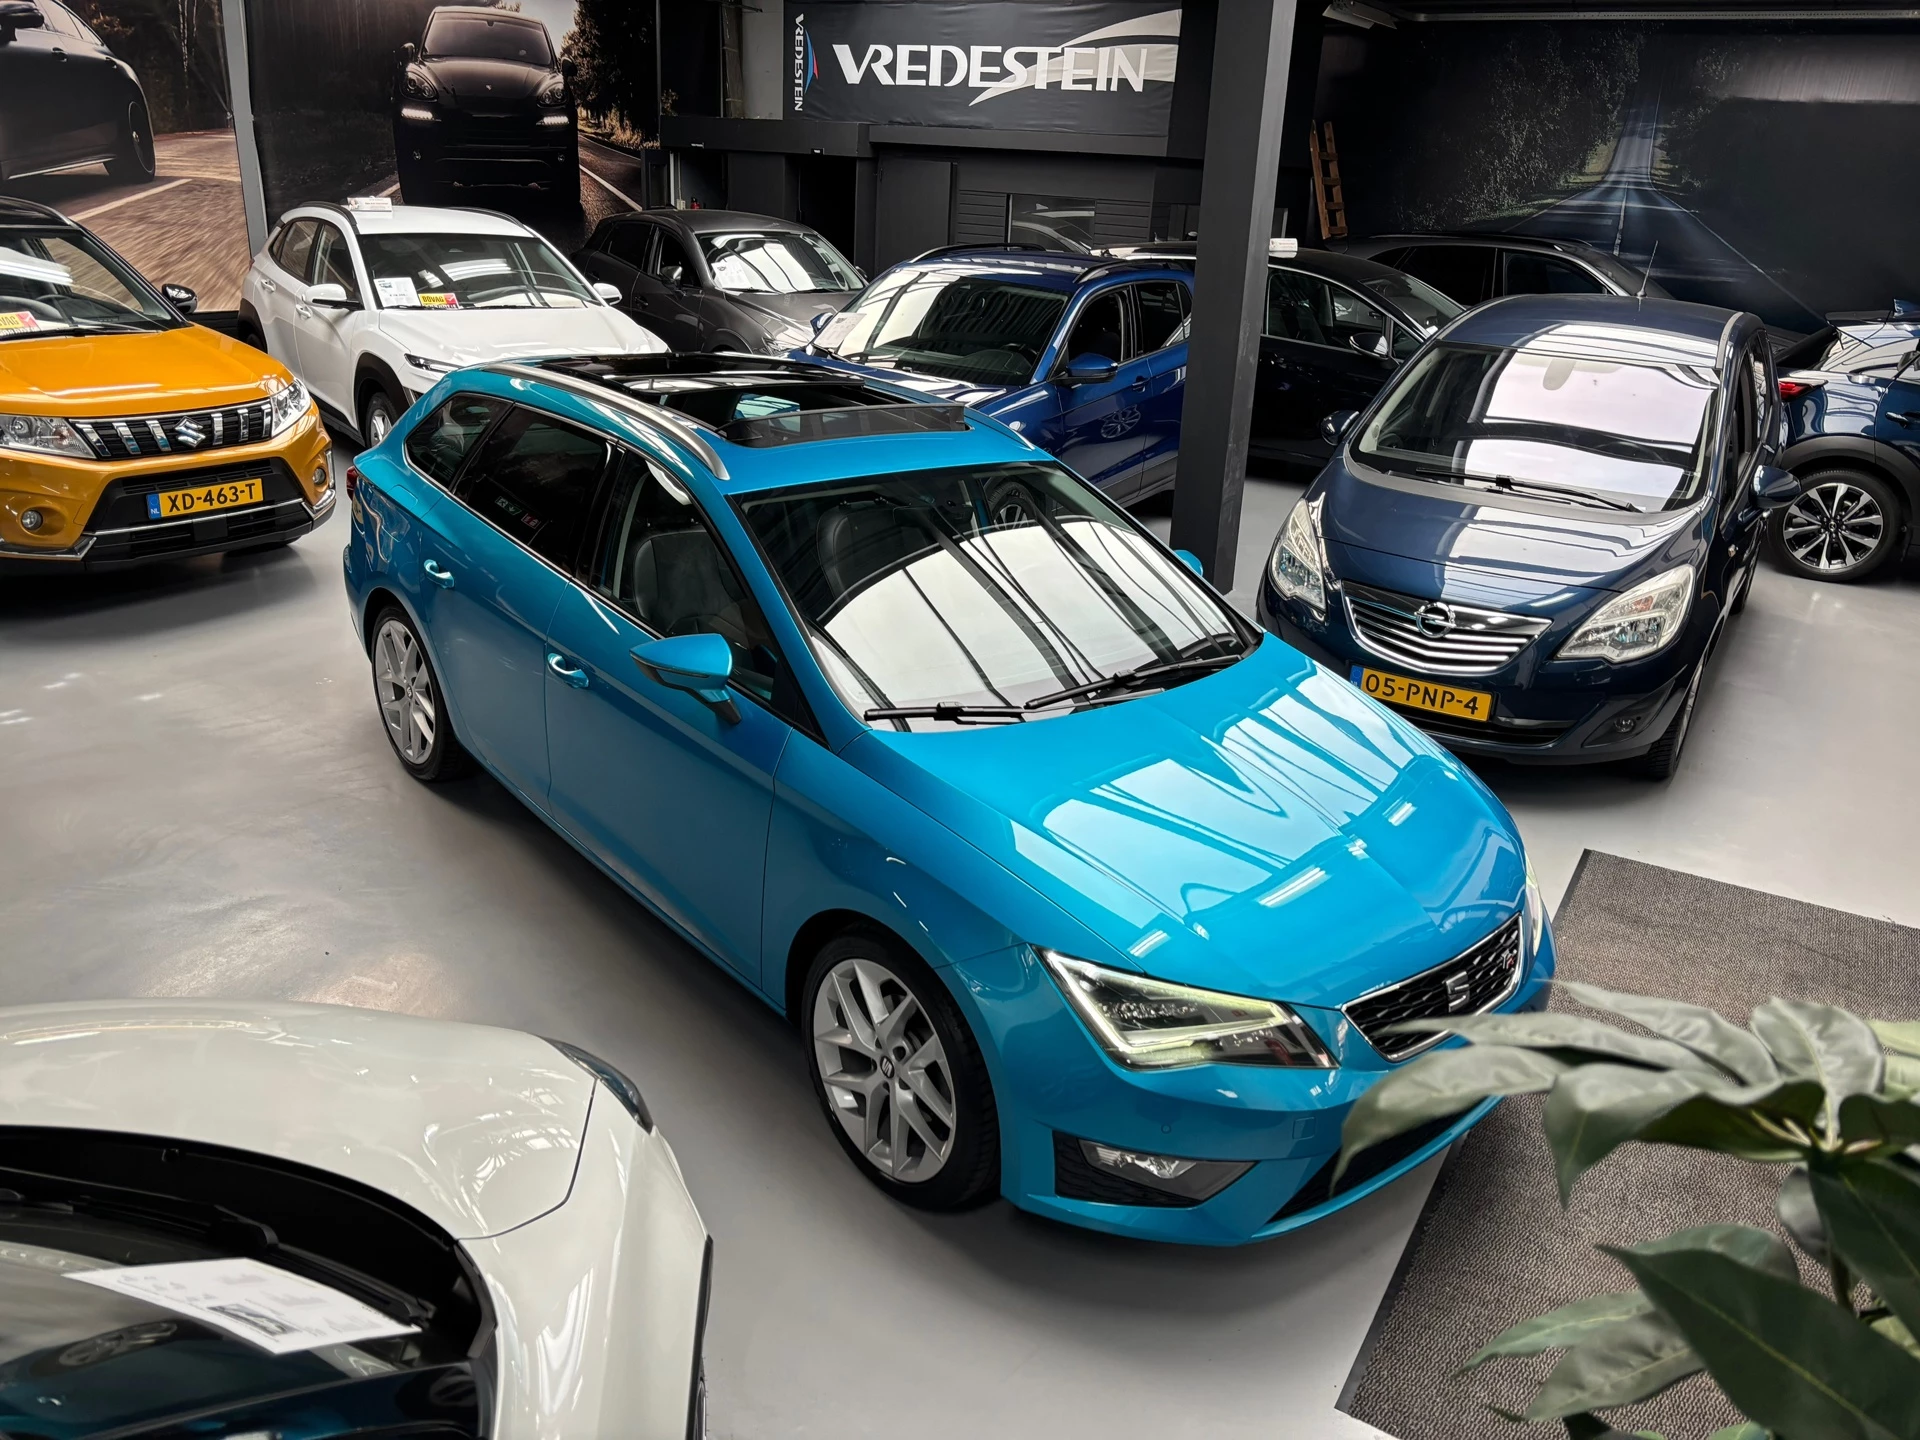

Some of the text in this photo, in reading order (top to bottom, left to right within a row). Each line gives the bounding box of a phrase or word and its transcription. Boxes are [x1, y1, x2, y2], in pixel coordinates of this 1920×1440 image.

[795, 13, 804, 111] VREDESTEIN
[832, 43, 1148, 92] VREDESTEIN
[167, 483, 256, 513] XD-463-T
[1365, 674, 1479, 715] 05-PNP-4
